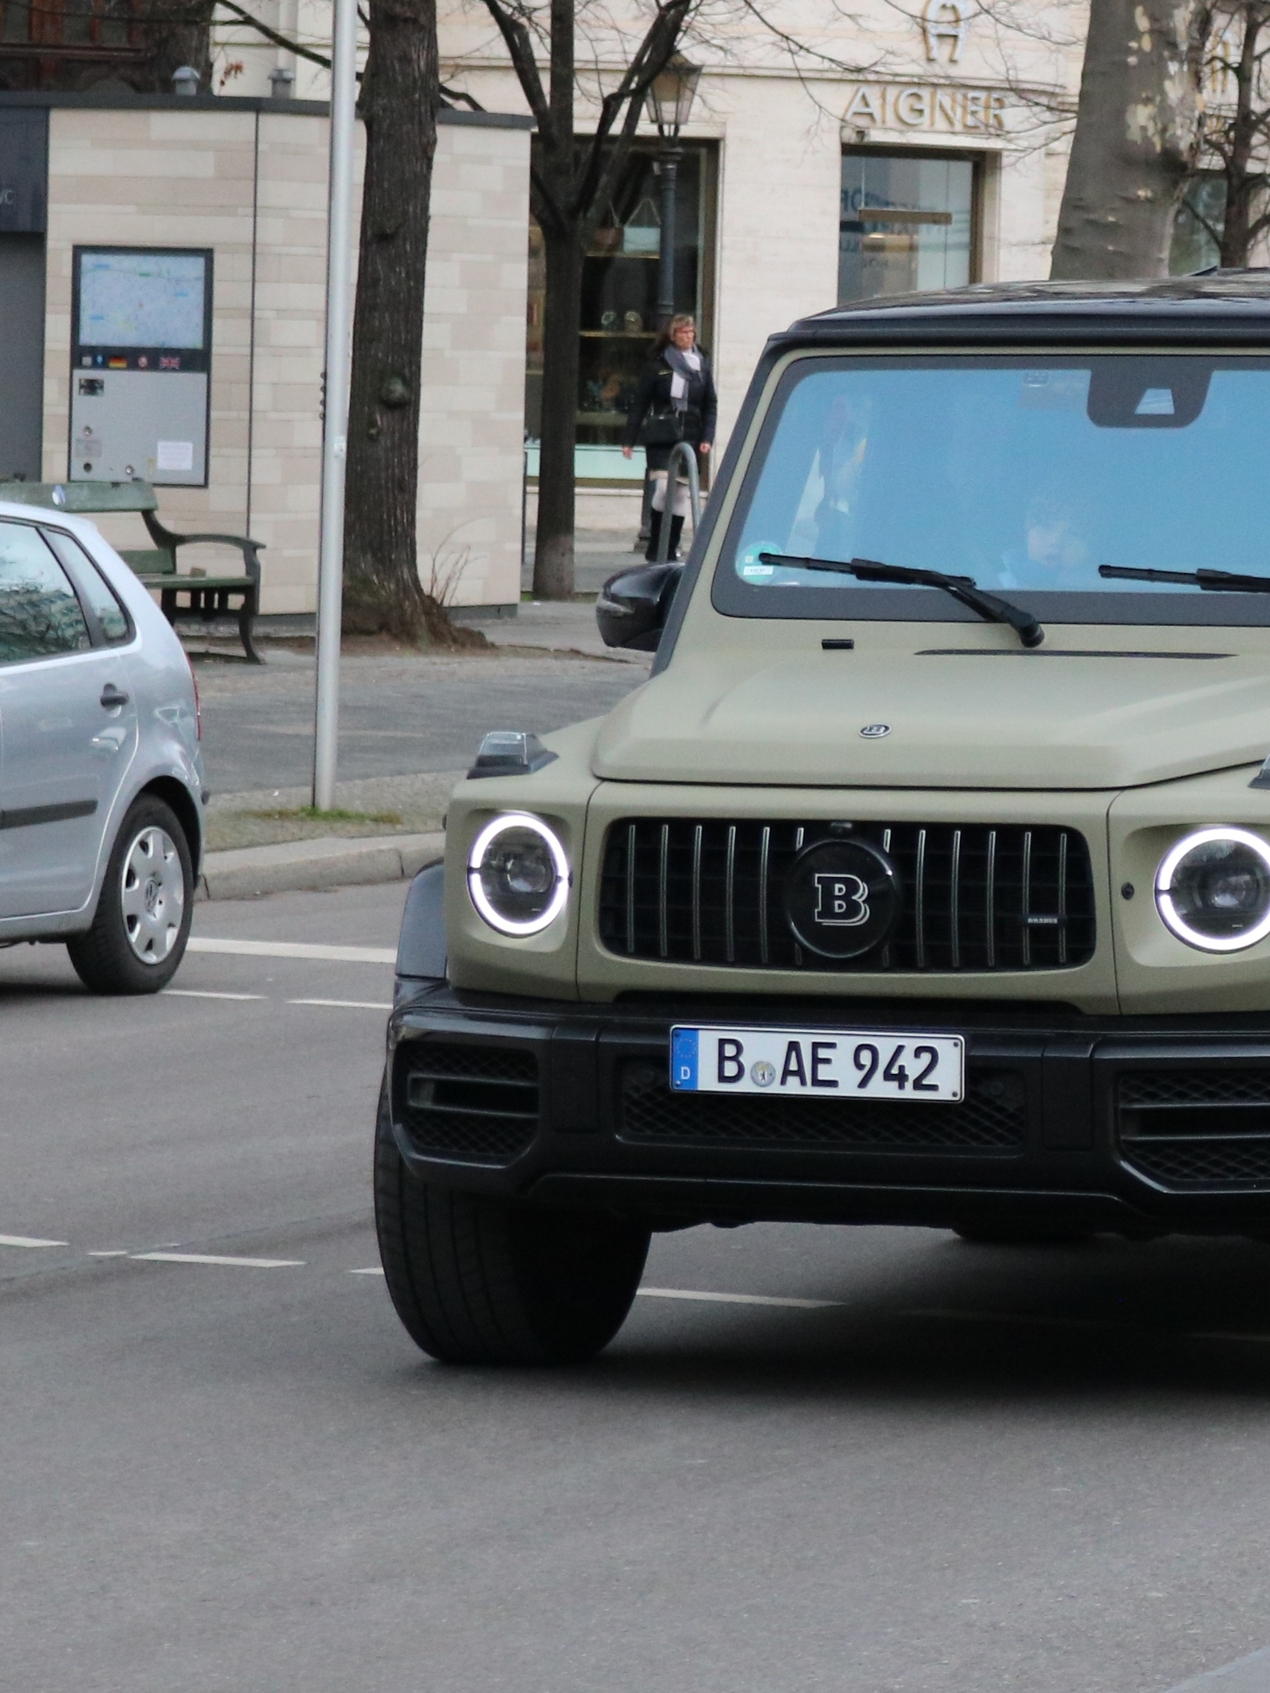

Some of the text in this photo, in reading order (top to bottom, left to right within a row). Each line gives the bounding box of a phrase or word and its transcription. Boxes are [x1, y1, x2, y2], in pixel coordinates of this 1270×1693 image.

[844, 85, 1007, 130] AIGNER
[814, 873, 870, 926] B
[679, 1066, 691, 1080] D
[717, 1037, 940, 1092] B AE 942
